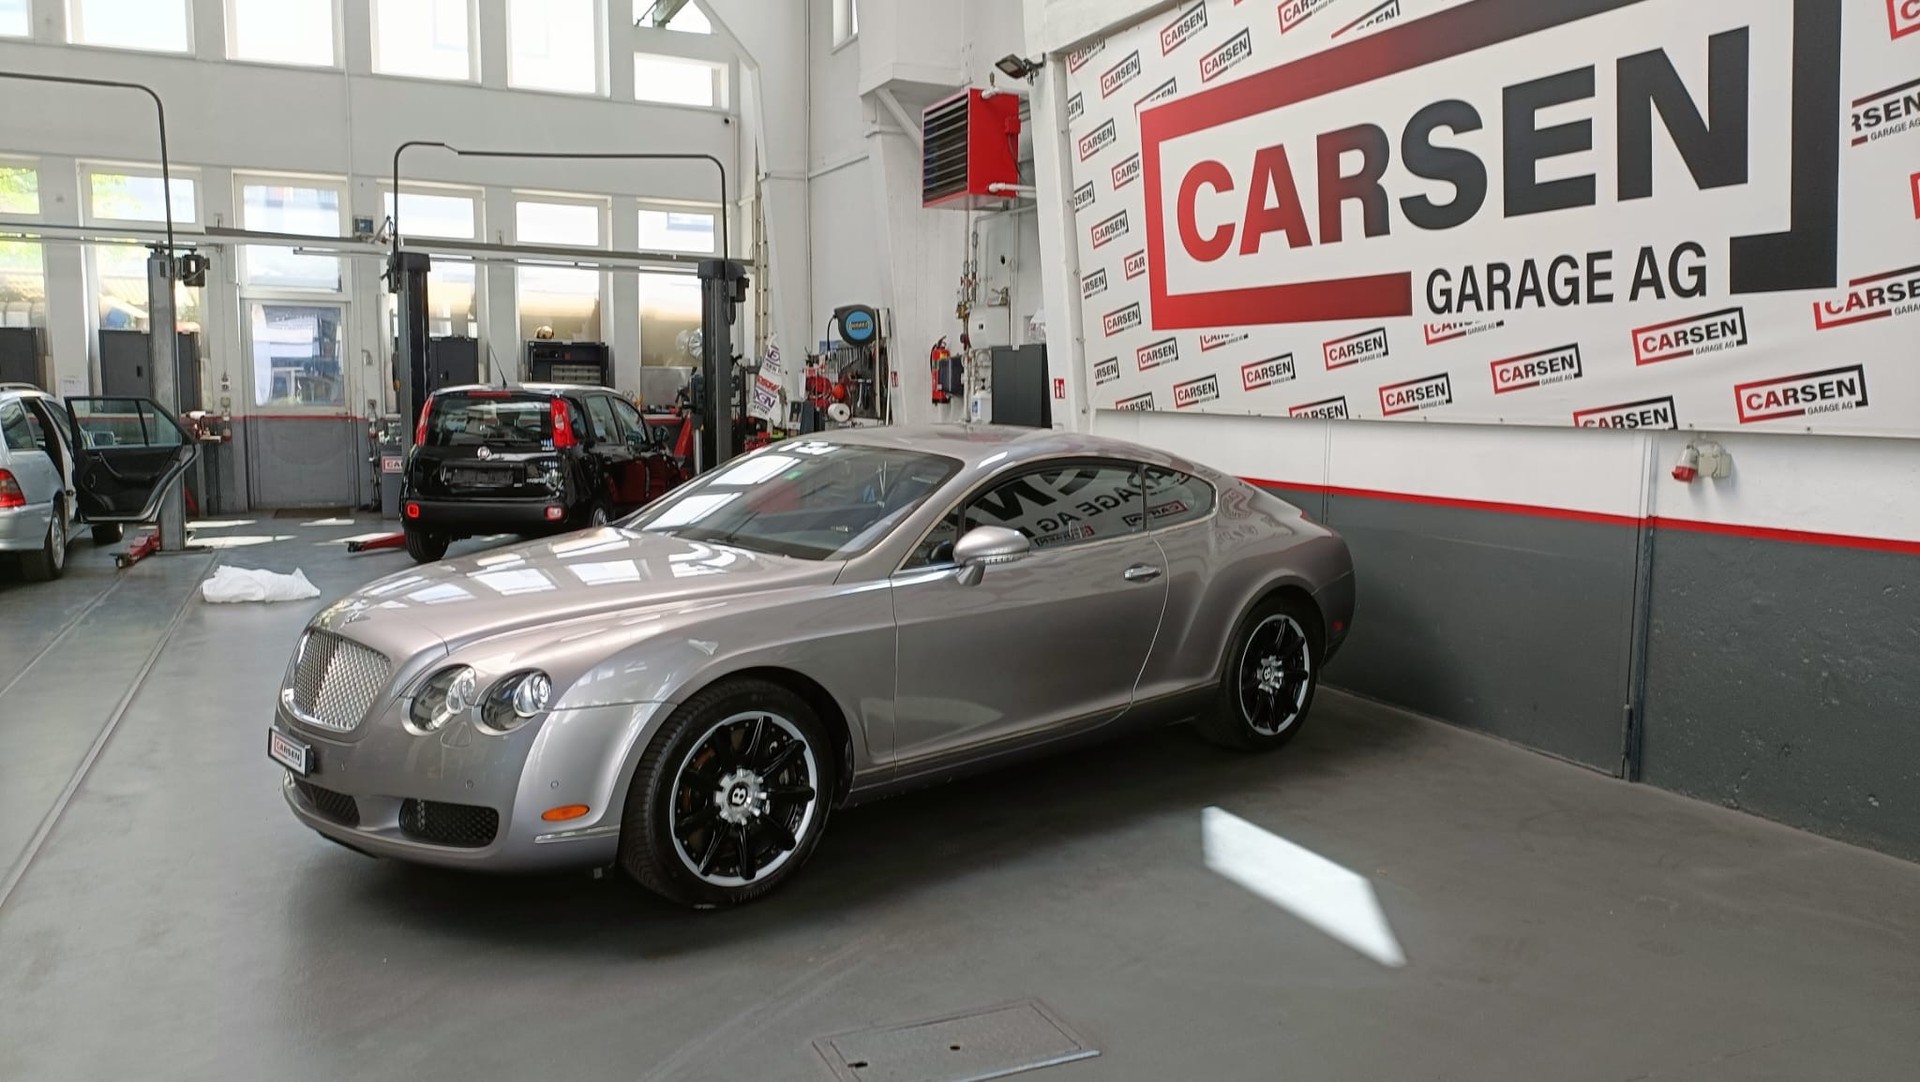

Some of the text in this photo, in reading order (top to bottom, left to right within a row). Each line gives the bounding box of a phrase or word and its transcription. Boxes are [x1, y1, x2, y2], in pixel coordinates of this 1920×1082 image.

[1164, 9, 1204, 46] CARSEN
[1204, 37, 1247, 74] CARSEN
[1104, 58, 1138, 90] CARSEN
[1082, 125, 1113, 154] CARSEN
[1870, 121, 1907, 141] GARAGE
[1177, 26, 1749, 262] CARSEN
[1094, 216, 1125, 241] CARSEN
[1426, 241, 1707, 315] GARAGE AG
[1106, 309, 1139, 330] CARSEN
[1329, 336, 1383, 361] CARSEN
[1642, 319, 1737, 353] CARSEN
[1695, 341, 1734, 355] GARAGE AG
[1140, 343, 1175, 364] CARSEN
[1246, 360, 1291, 383] CARSEN
[1499, 353, 1574, 383] CARSEN
[1177, 381, 1216, 401] CARSEN
[1385, 382, 1446, 407] CARSEN
[1746, 377, 1856, 411] CARSEN
[1807, 401, 1853, 415] GARAGE AG
